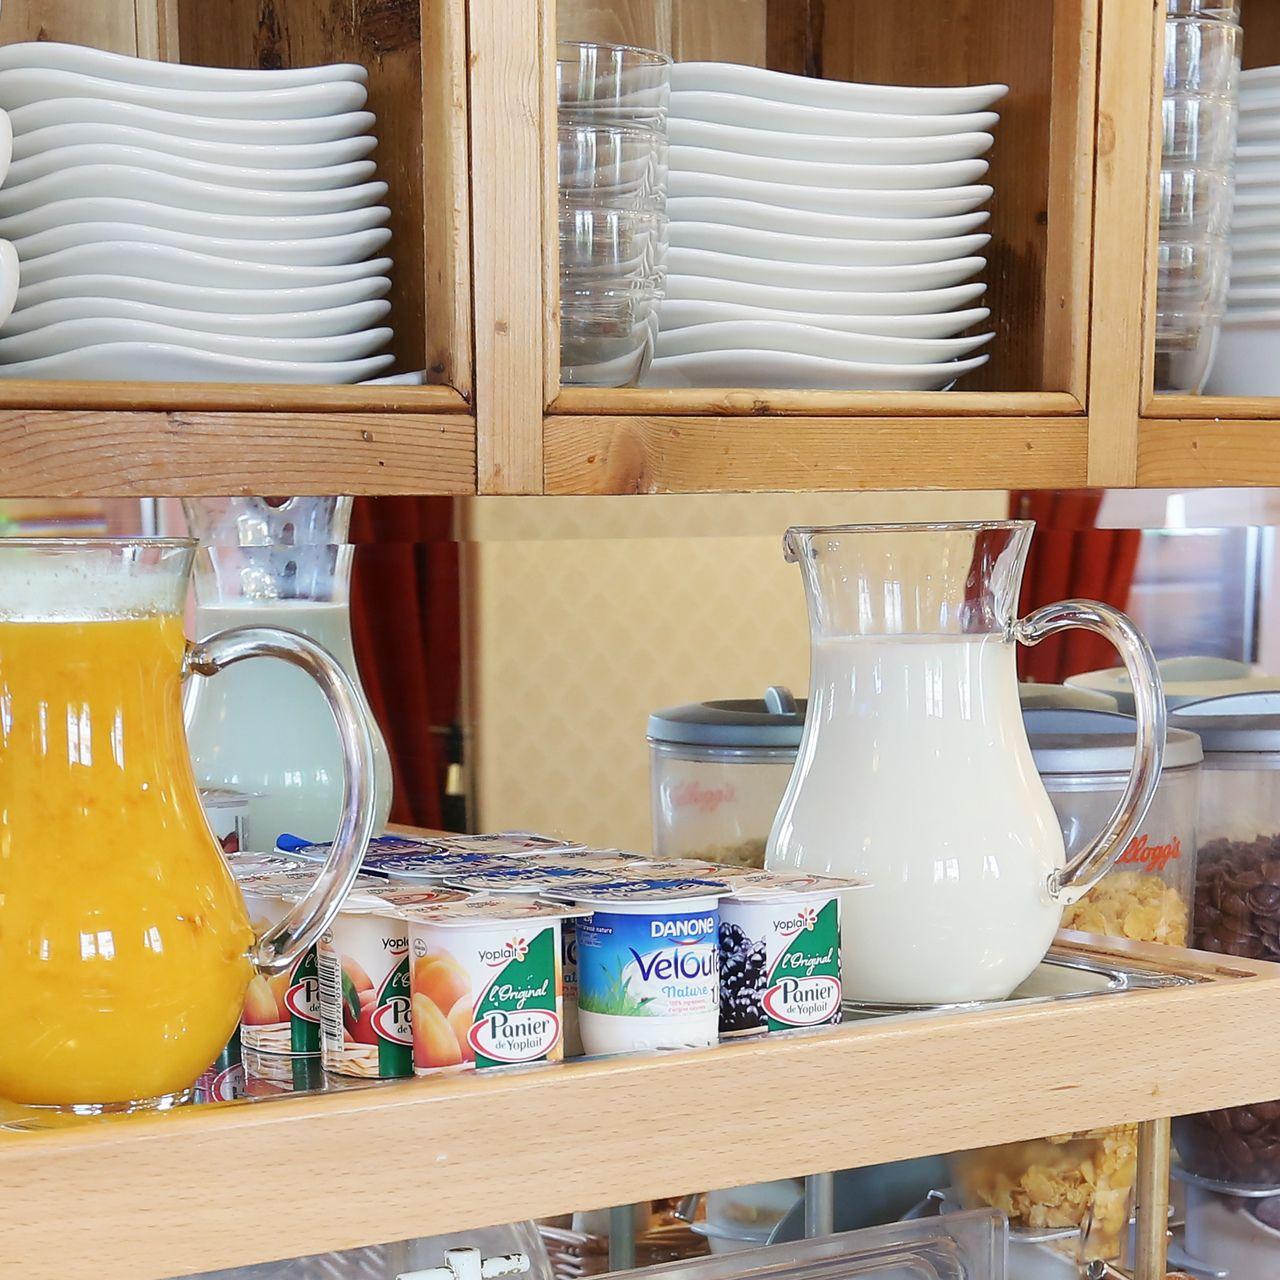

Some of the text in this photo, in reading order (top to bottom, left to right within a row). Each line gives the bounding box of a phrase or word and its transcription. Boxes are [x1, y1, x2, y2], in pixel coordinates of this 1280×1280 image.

[1114, 834, 1181, 872] llogg's
[783, 979, 833, 1004] Panier
[787, 1002, 828, 1015] de Yoplait
[490, 1013, 550, 1039] Panier
[495, 1037, 543, 1051] de Yoplait
